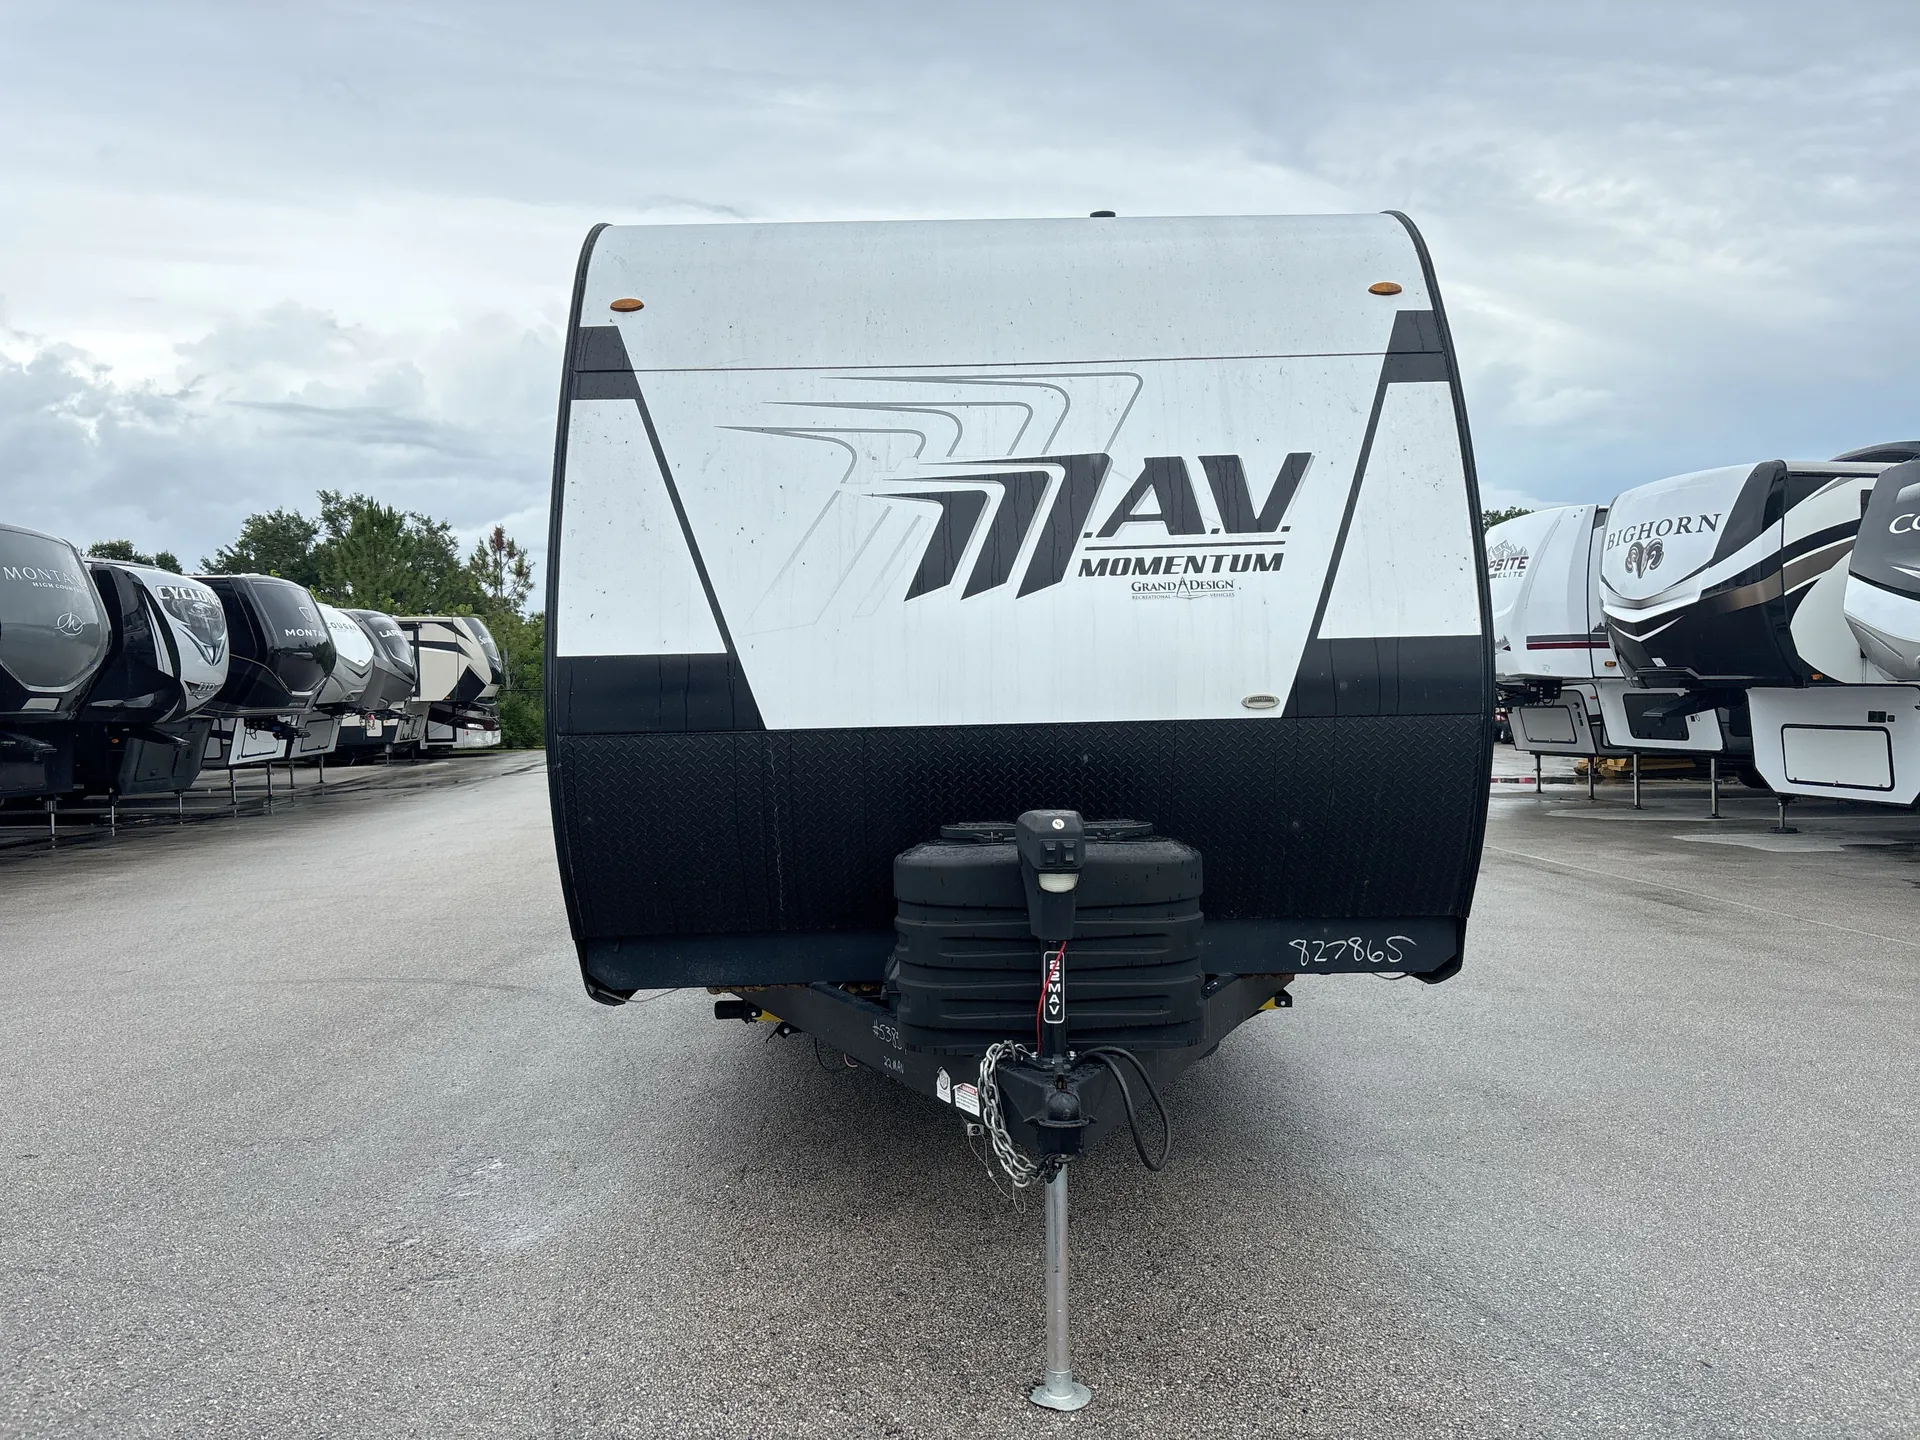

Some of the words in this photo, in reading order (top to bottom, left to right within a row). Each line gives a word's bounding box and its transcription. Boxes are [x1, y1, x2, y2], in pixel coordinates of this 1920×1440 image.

[1606, 513, 1722, 551] BIGHORN
[1078, 552, 1285, 577] MOMENTUM
[1131, 581, 1177, 592] GRAND
[1189, 579, 1234, 590] DESIGN
[197, 682, 216, 691] HD
[1288, 935, 1418, 967] 827865
